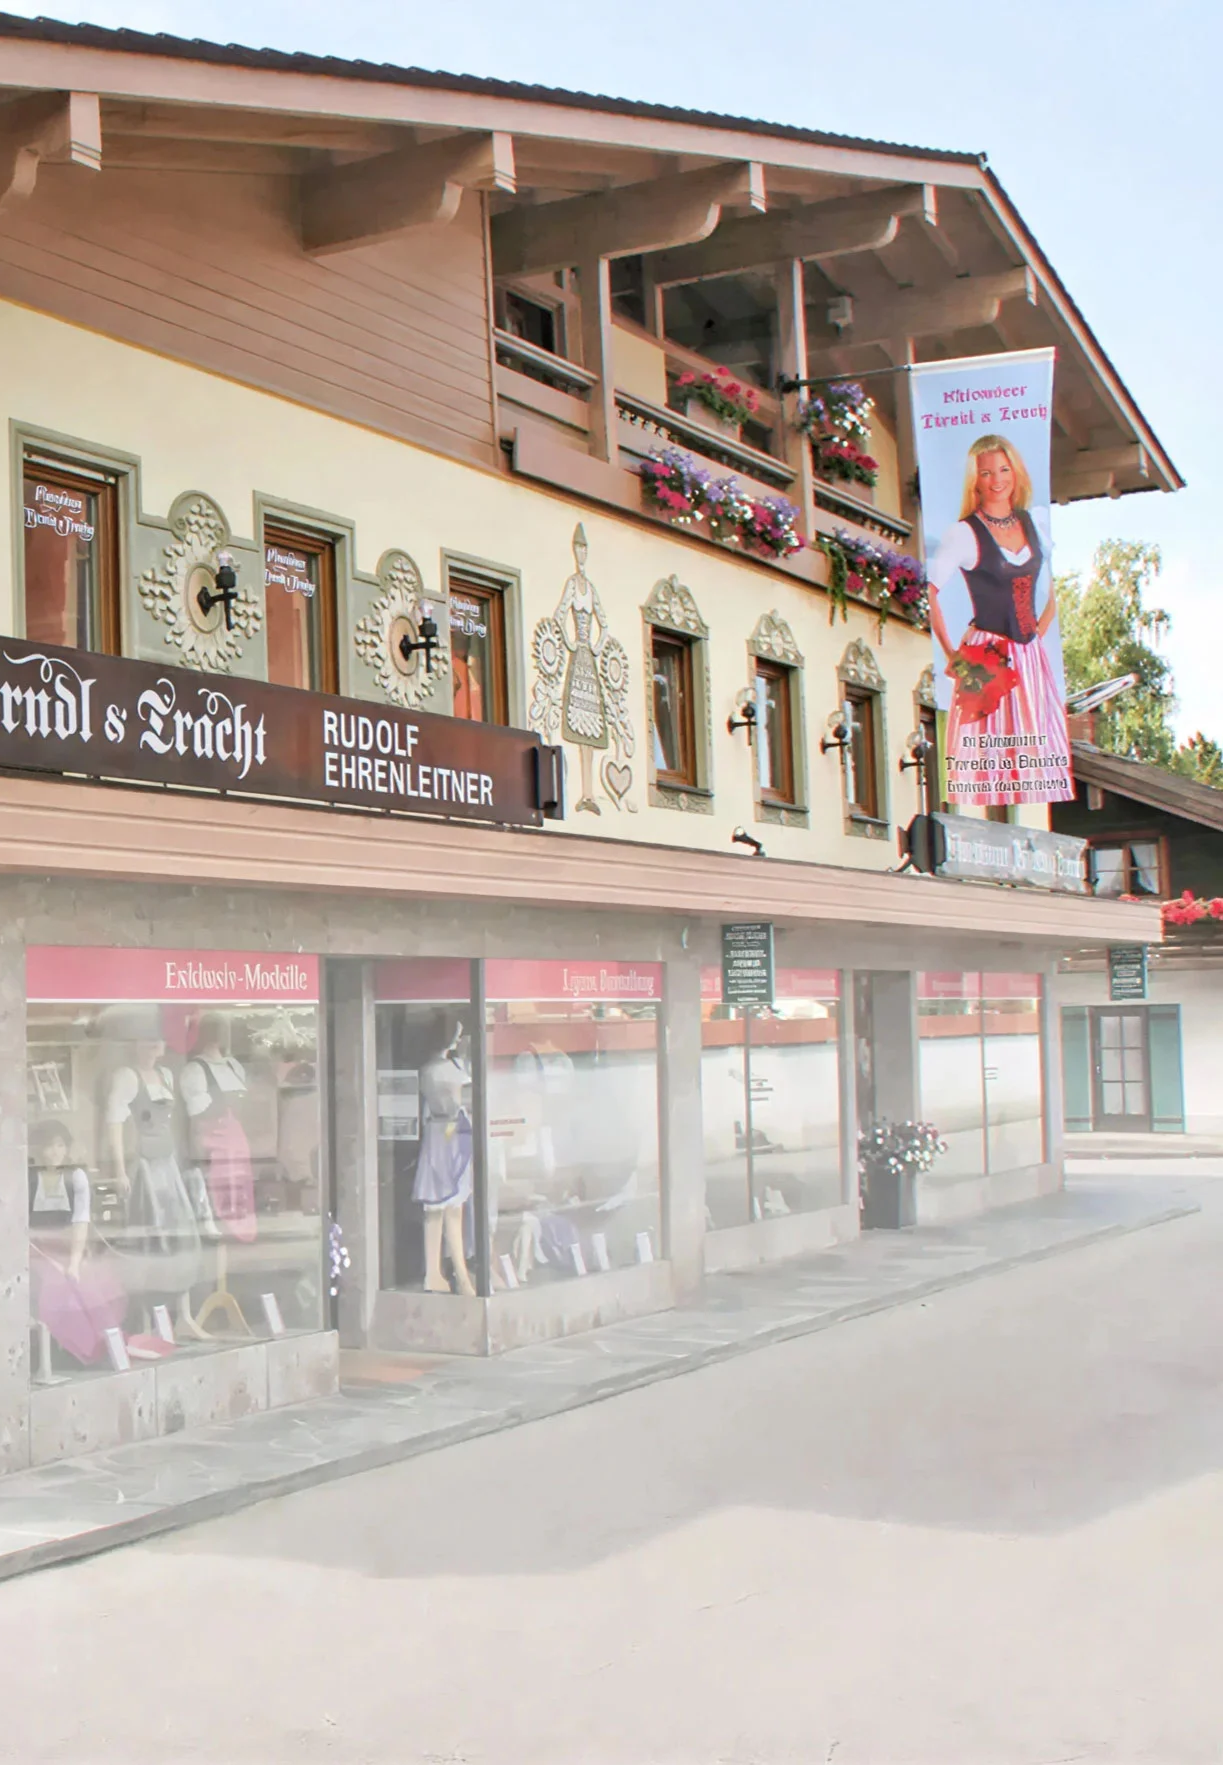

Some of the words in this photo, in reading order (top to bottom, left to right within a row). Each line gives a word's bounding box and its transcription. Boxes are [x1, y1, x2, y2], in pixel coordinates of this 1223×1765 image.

[137, 677, 267, 780] Tracht
[323, 709, 420, 757] RUDOLF
[324, 752, 494, 806] EHRENLEITNER
